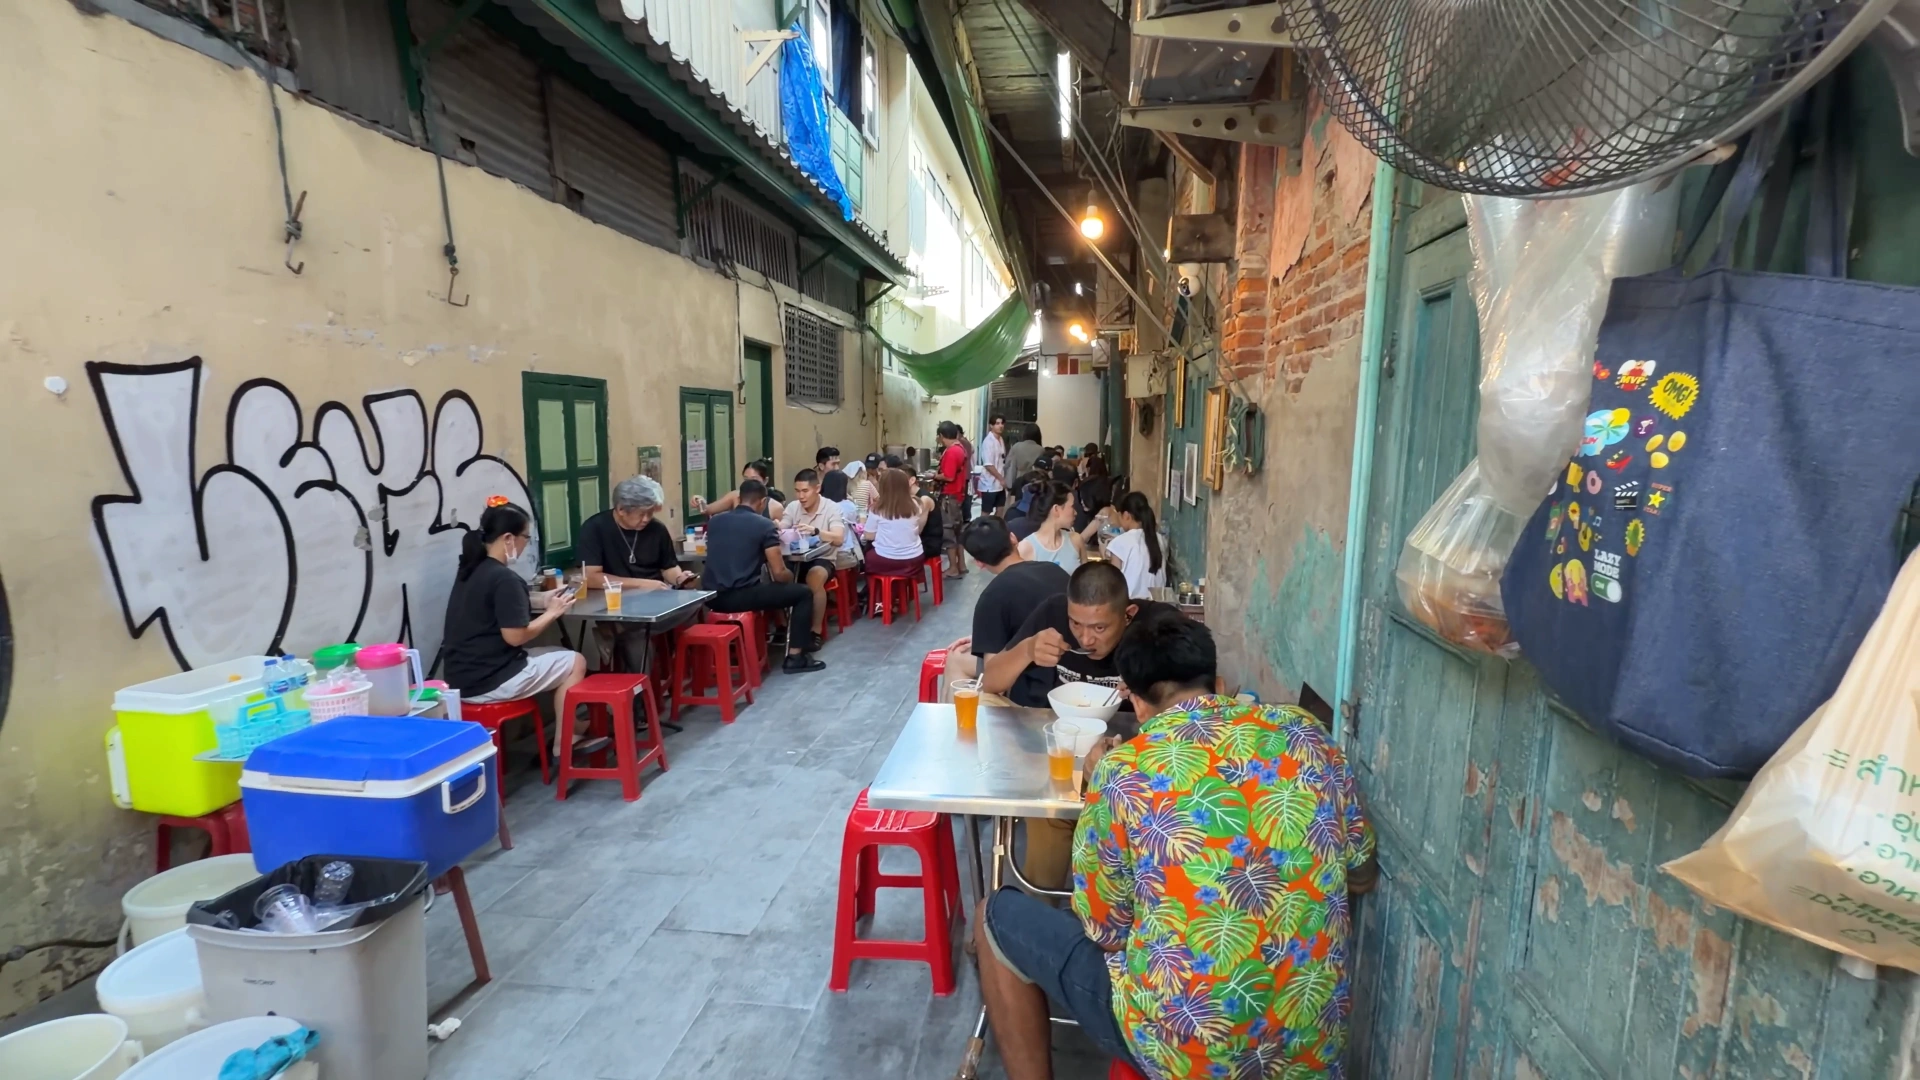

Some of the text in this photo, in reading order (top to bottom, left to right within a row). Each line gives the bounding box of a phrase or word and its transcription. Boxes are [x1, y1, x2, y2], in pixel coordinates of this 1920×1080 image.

[1620, 374, 1646, 385] MVP
[1663, 377, 1693, 406] OMG!
[1594, 549, 1621, 567] LAZY
[1594, 560, 1620, 579] MODE
